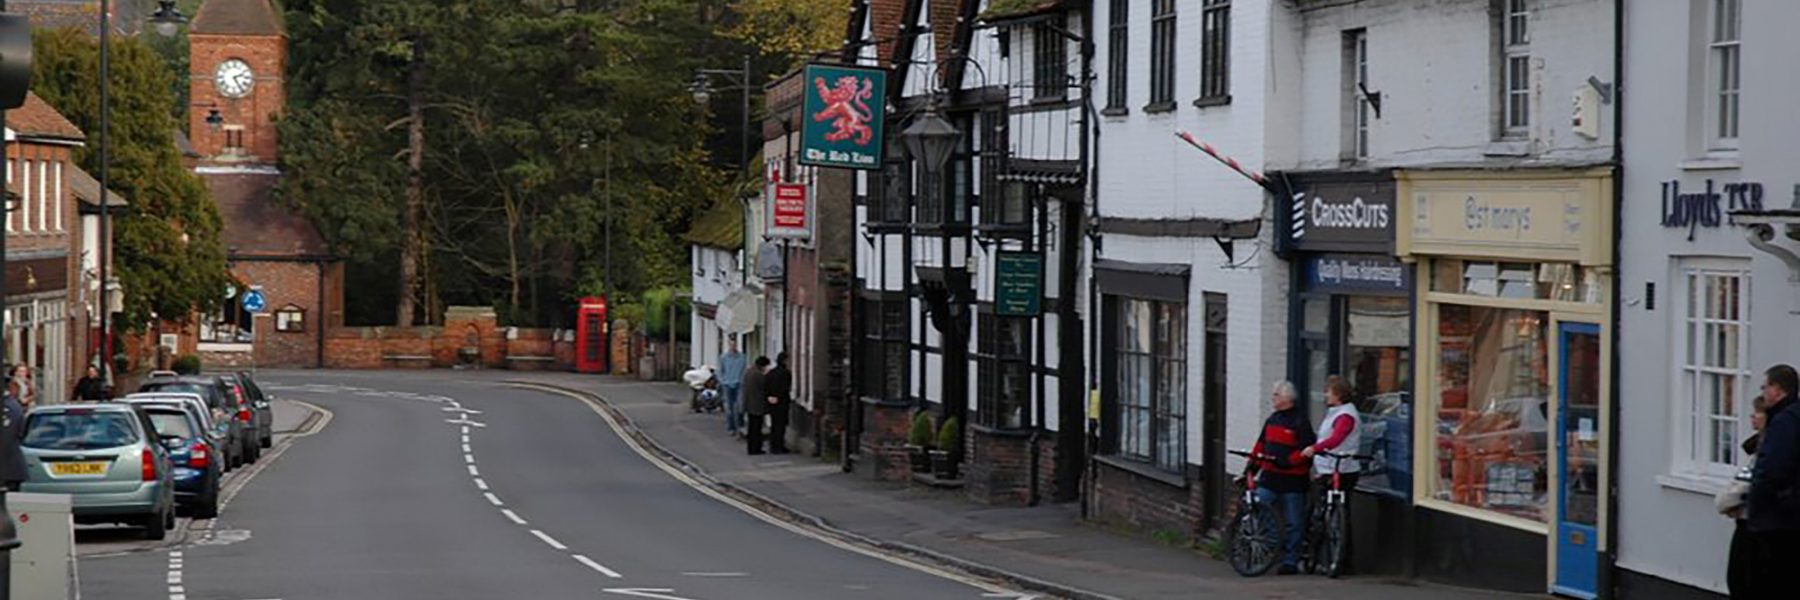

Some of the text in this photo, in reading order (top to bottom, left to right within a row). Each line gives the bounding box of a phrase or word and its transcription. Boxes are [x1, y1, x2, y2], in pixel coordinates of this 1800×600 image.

[805, 148, 875, 164] The Red Lion
[1660, 179, 1722, 242] Lloyds
